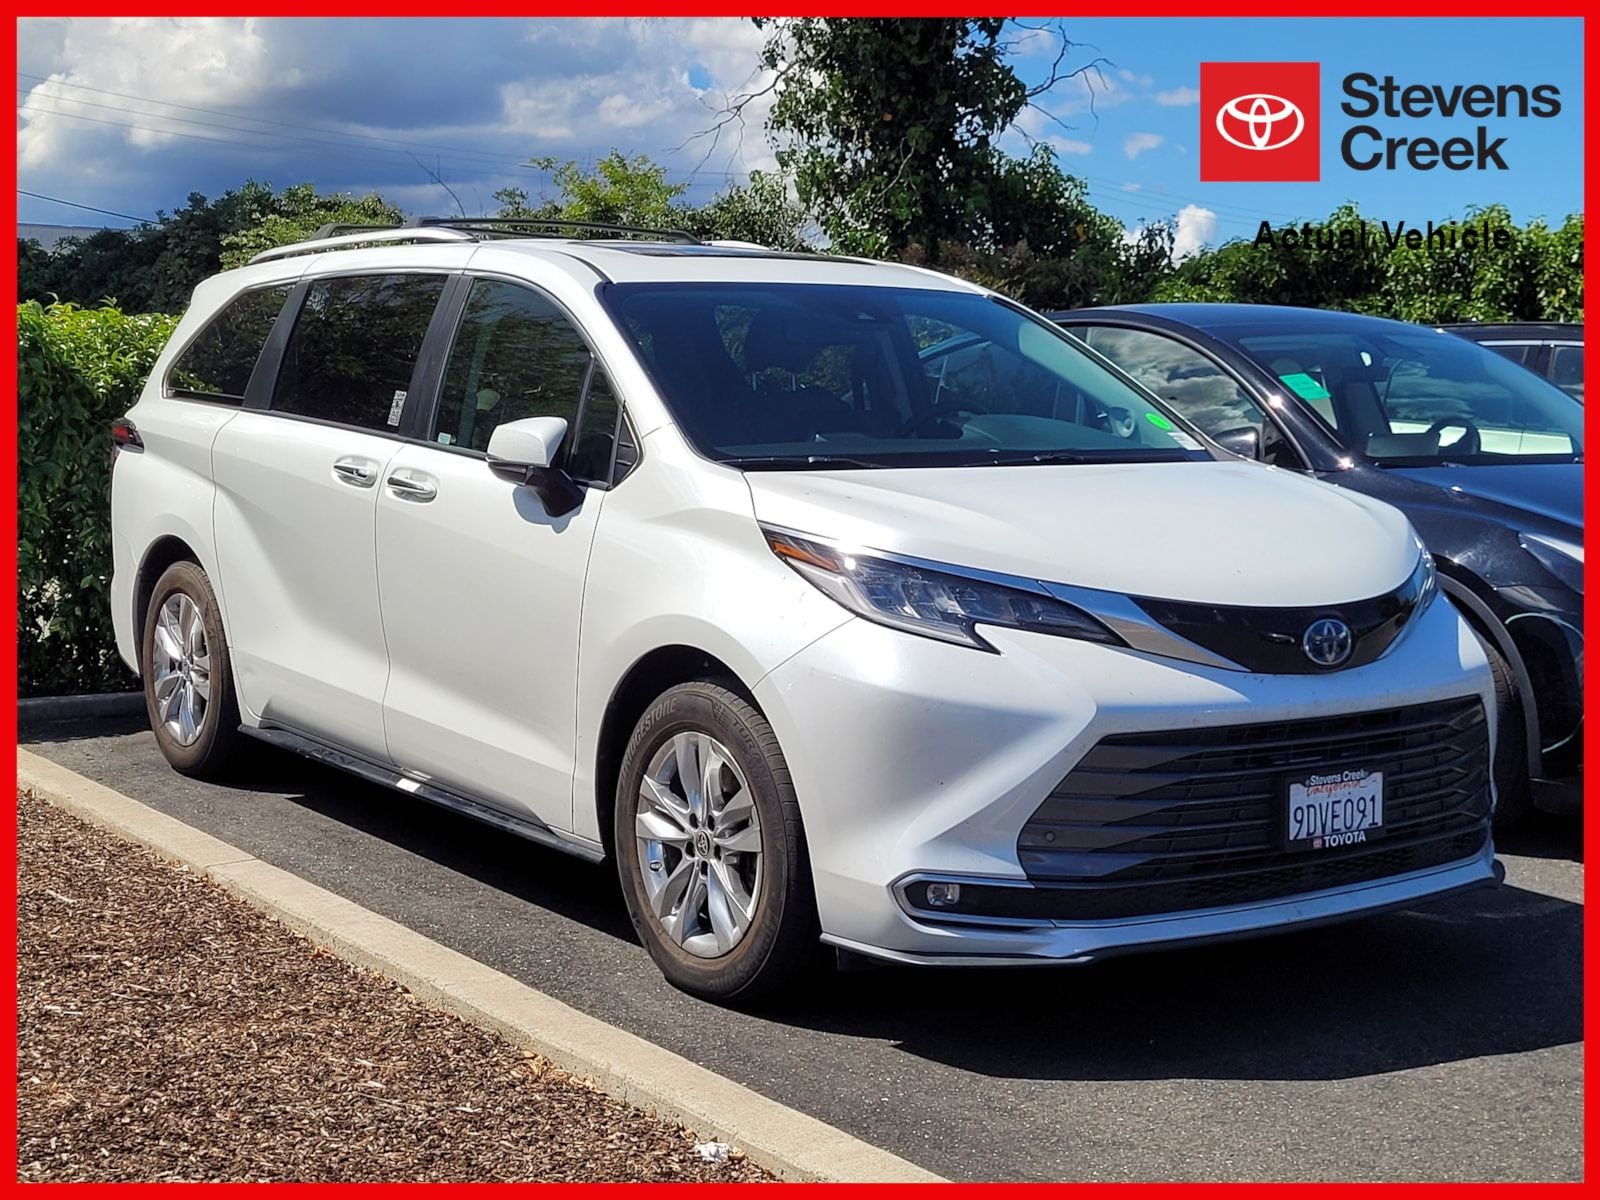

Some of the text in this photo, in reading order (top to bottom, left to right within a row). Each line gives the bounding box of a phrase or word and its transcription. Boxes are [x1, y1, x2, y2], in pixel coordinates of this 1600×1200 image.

[1310, 768, 1369, 786] Stevens Creek
[1293, 794, 1379, 840] 9DVE091
[1323, 830, 1366, 848] TOYOTA
